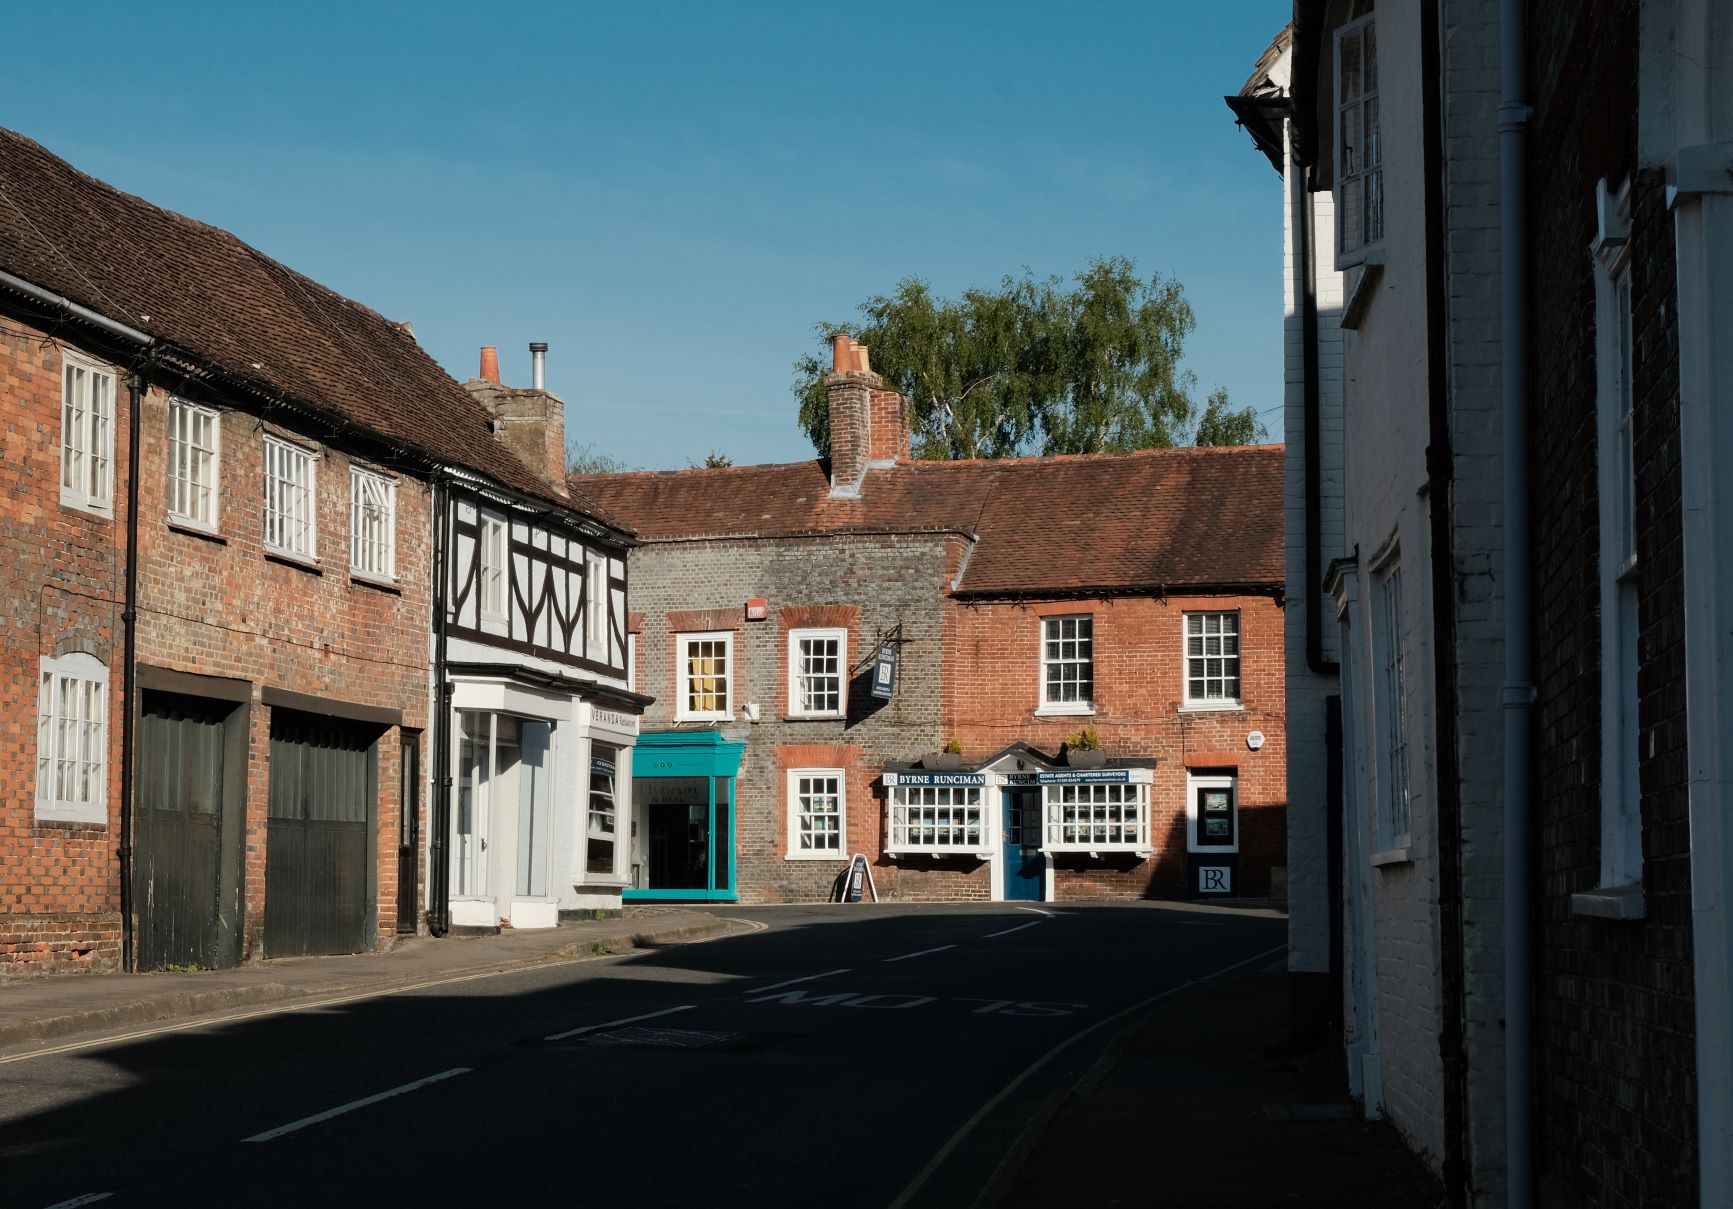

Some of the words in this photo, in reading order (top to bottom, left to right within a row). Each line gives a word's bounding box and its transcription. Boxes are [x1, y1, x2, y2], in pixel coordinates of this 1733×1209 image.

[591, 709, 619, 725] VERANDA
[885, 774, 898, 785] BR
[899, 775, 930, 784] BYRNE
[934, 775, 985, 784] RUNCIMAN
[1203, 869, 1227, 890] BR
